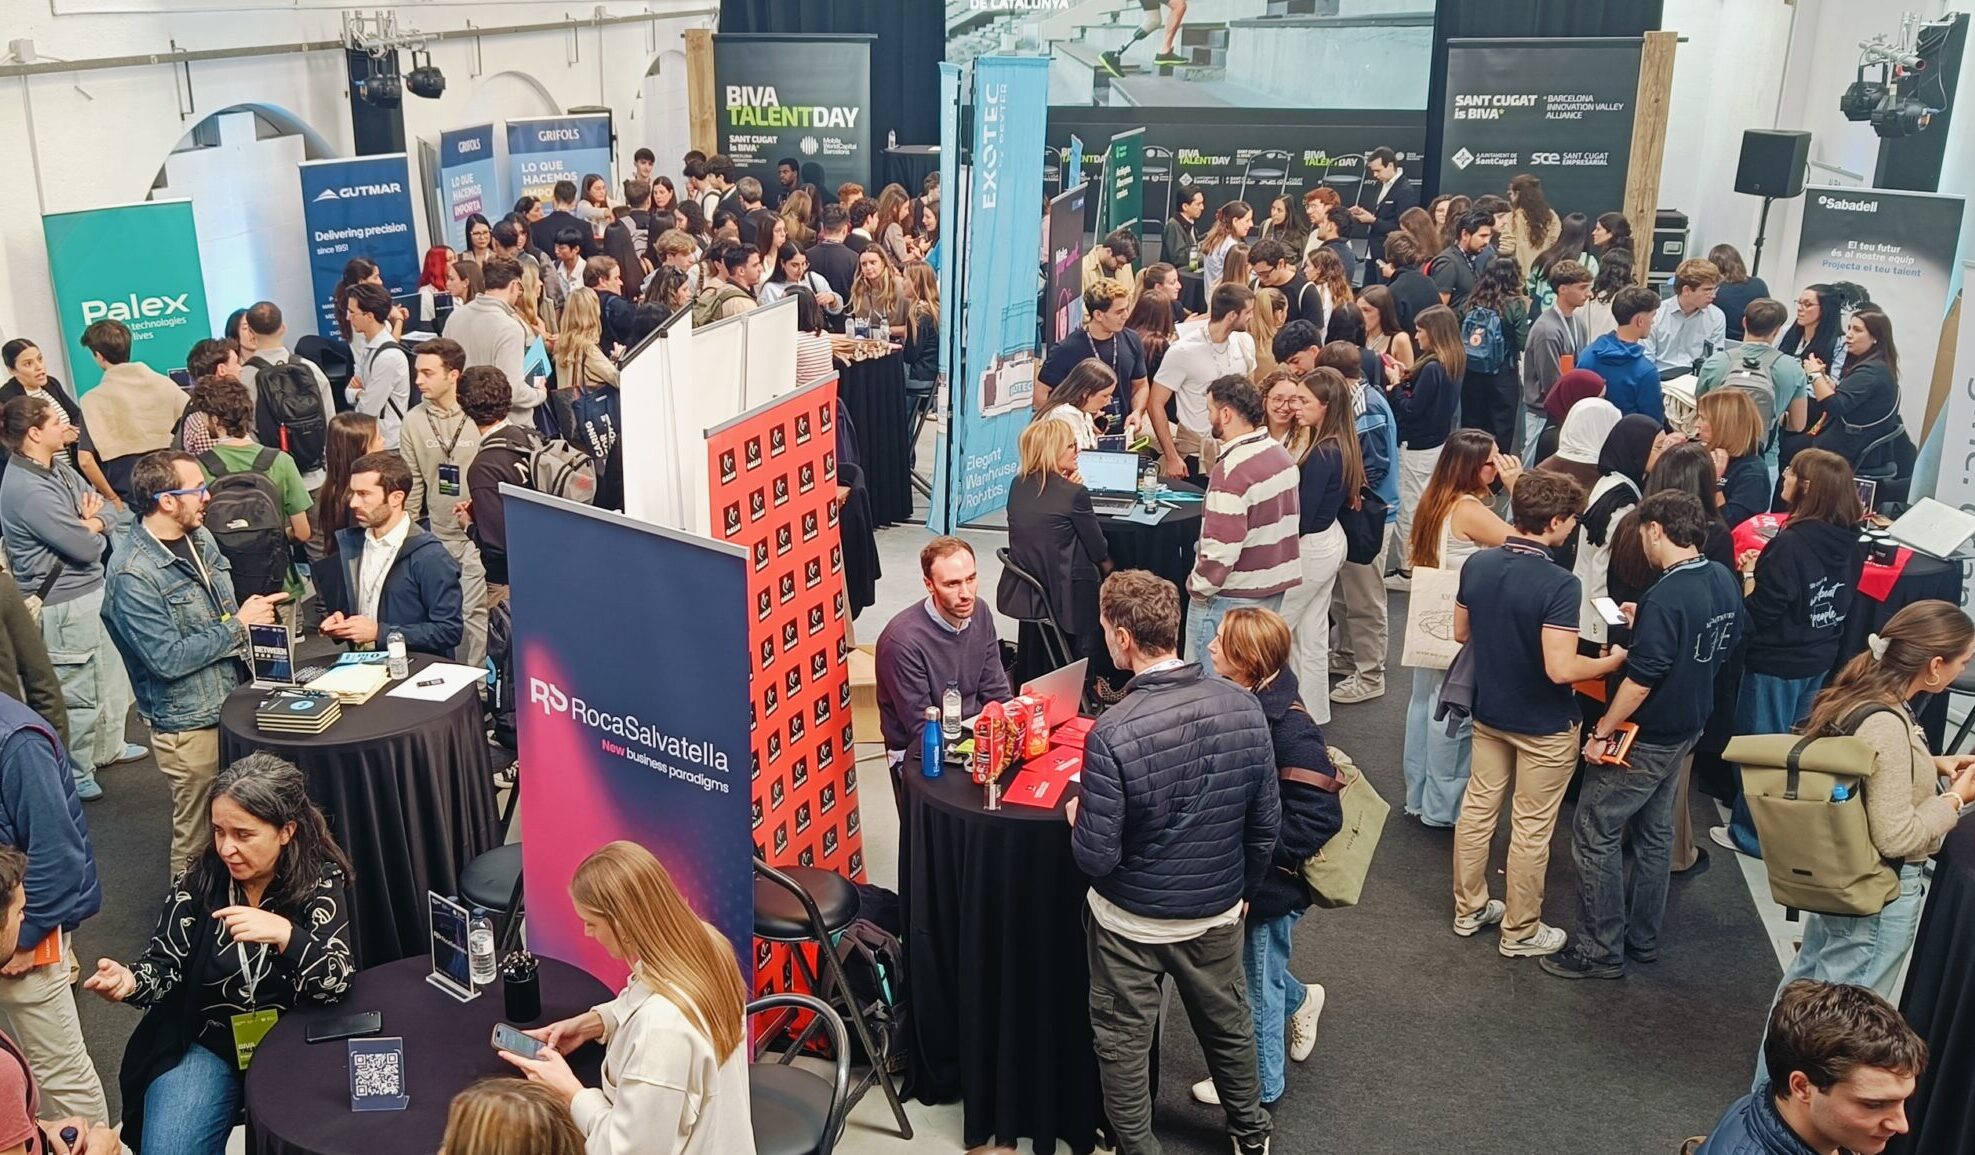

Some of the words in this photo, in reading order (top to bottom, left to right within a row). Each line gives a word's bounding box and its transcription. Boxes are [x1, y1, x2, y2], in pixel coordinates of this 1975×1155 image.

[990, 0, 1069, 9] CATALUNYA
[726, 85, 779, 107] BIVA
[1455, 95, 1491, 106] SANT
[1492, 95, 1538, 106] CUGAT
[1454, 108, 1466, 119] is
[1546, 103, 1594, 111] INNOVATION
[1595, 103, 1624, 111] VALLEY
[726, 106, 859, 128] TALENTDAY
[538, 129, 580, 142] GRIFOLS
[729, 135, 751, 144] SANT
[751, 136, 778, 144] CUGAT
[458, 138, 481, 153] GRIFOLS
[982, 83, 999, 209] EXOTEC
[521, 163, 537, 173] LO
[539, 160, 564, 171] QUE
[1179, 156, 1231, 165] TALENTDAY
[1475, 158, 1518, 166] SantCugat
[523, 172, 578, 185] HACEMOS
[340, 183, 401, 198] GUTMAR
[1826, 198, 1878, 213] Sabadell
[315, 227, 364, 241] Delivering
[364, 223, 407, 238] precision
[1848, 241, 1858, 249] El
[1860, 242, 1875, 251] teu
[1877, 243, 1901, 254] futur
[1856, 253, 1886, 262] nostre
[1888, 255, 1915, 265] equip
[1822, 260, 1861, 271] Projecta
[1875, 264, 1890, 273] teu
[1893, 265, 1922, 277] talent
[81, 293, 190, 326] Palex
[132, 317, 187, 331] technologies
[585, 421, 604, 457] CARING
[254, 645, 288, 656] BETWEEN
[571, 697, 729, 773] RocaSalvatella
[601, 739, 625, 756] New
[626, 747, 668, 774] business
[669, 766, 729, 793] paradigms
